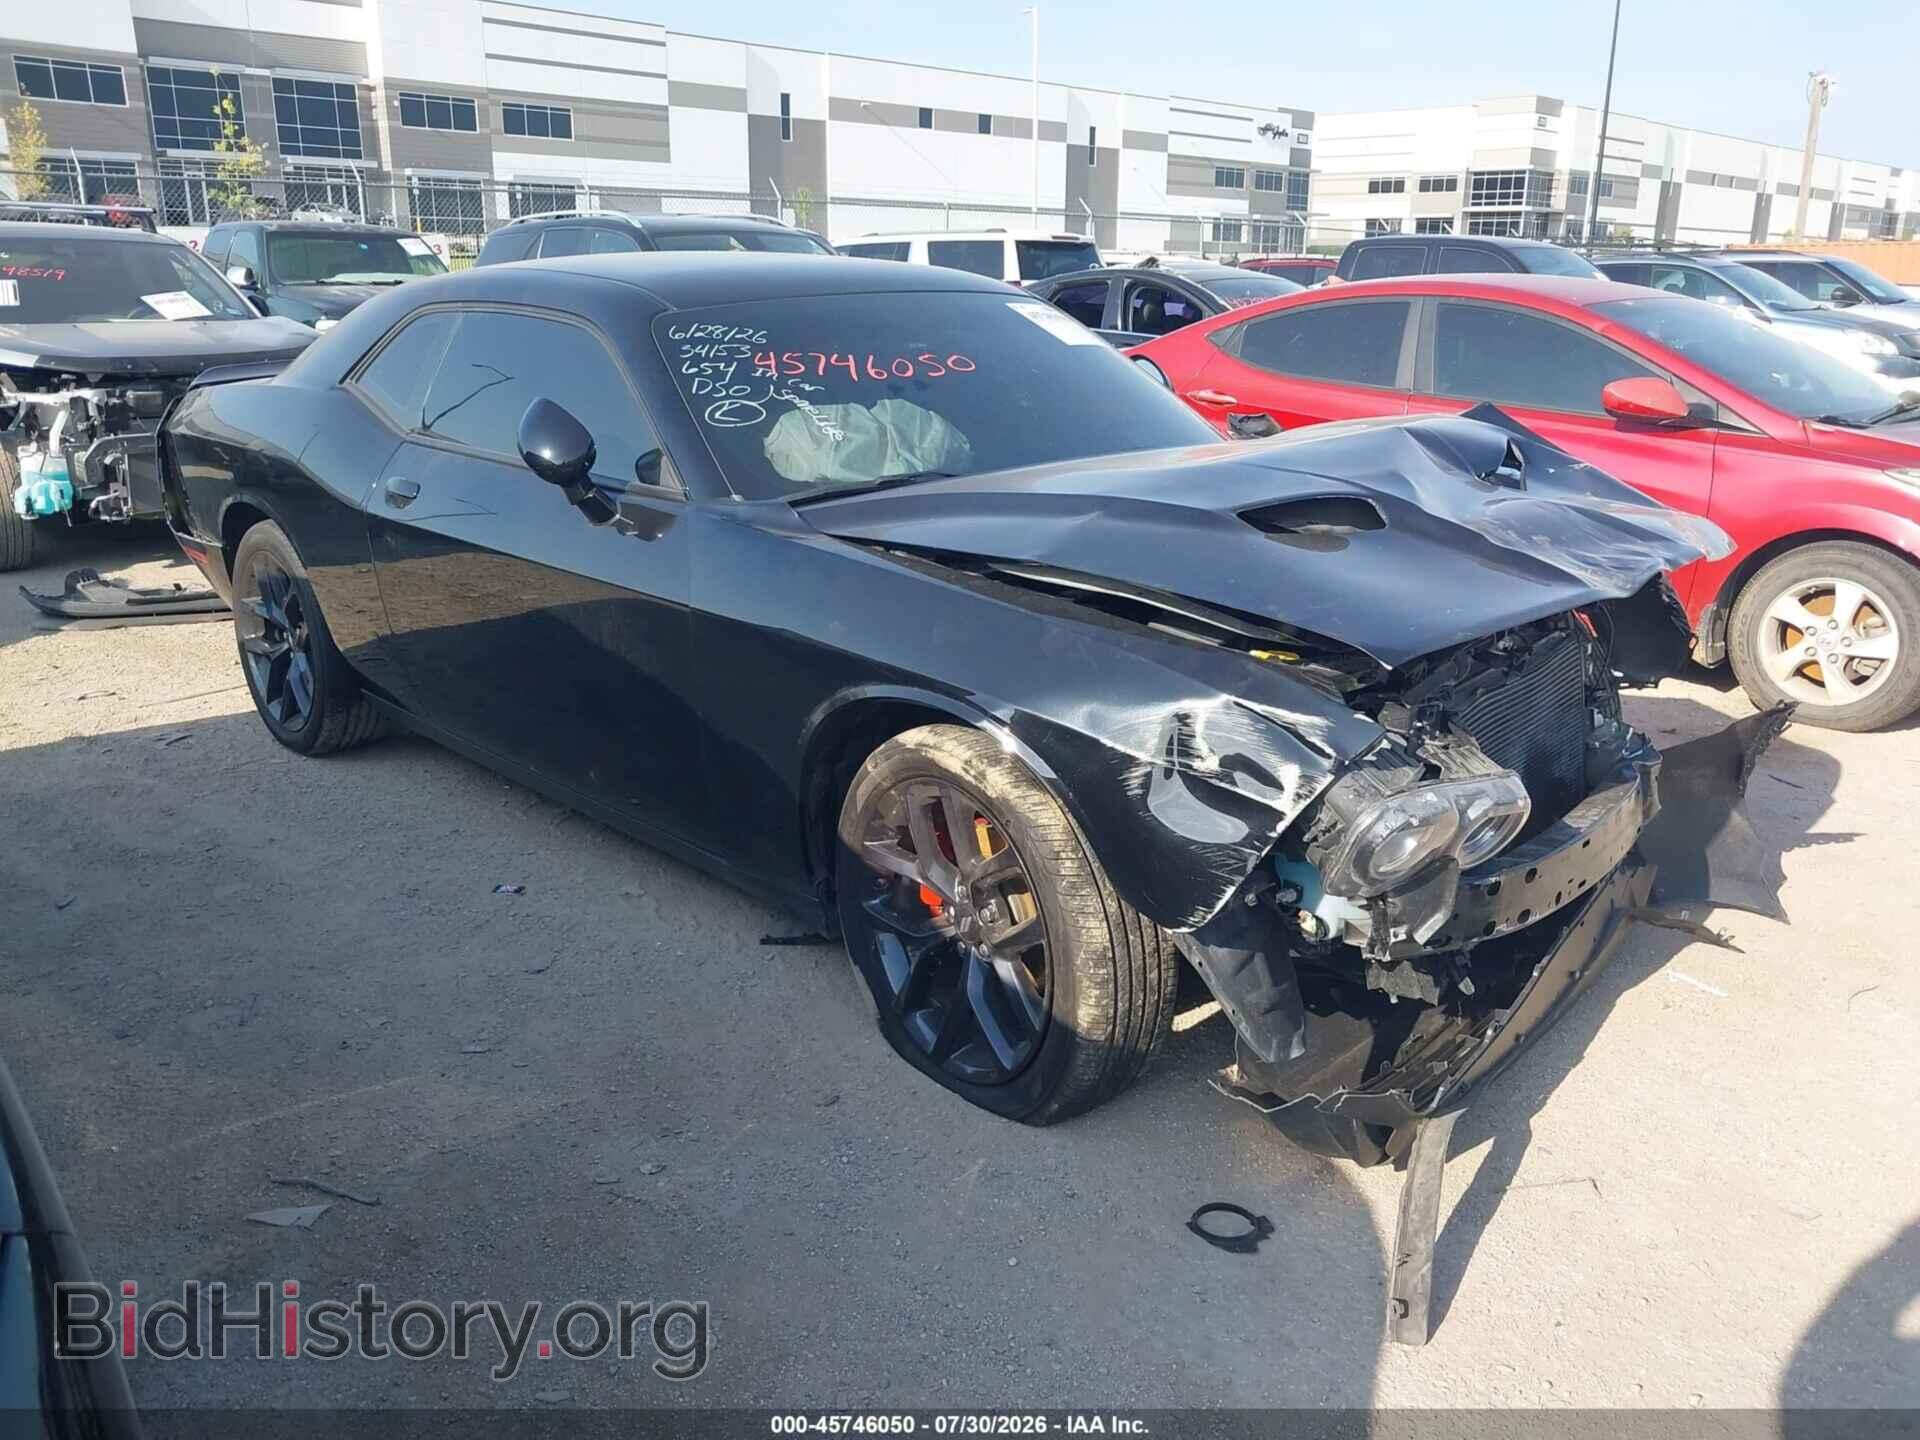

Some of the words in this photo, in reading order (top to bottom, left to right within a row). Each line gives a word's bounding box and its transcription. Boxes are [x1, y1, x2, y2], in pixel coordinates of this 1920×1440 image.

[668, 322, 768, 344] 6/28/26
[681, 361, 738, 384] 654
[754, 351, 977, 382] 45746050
